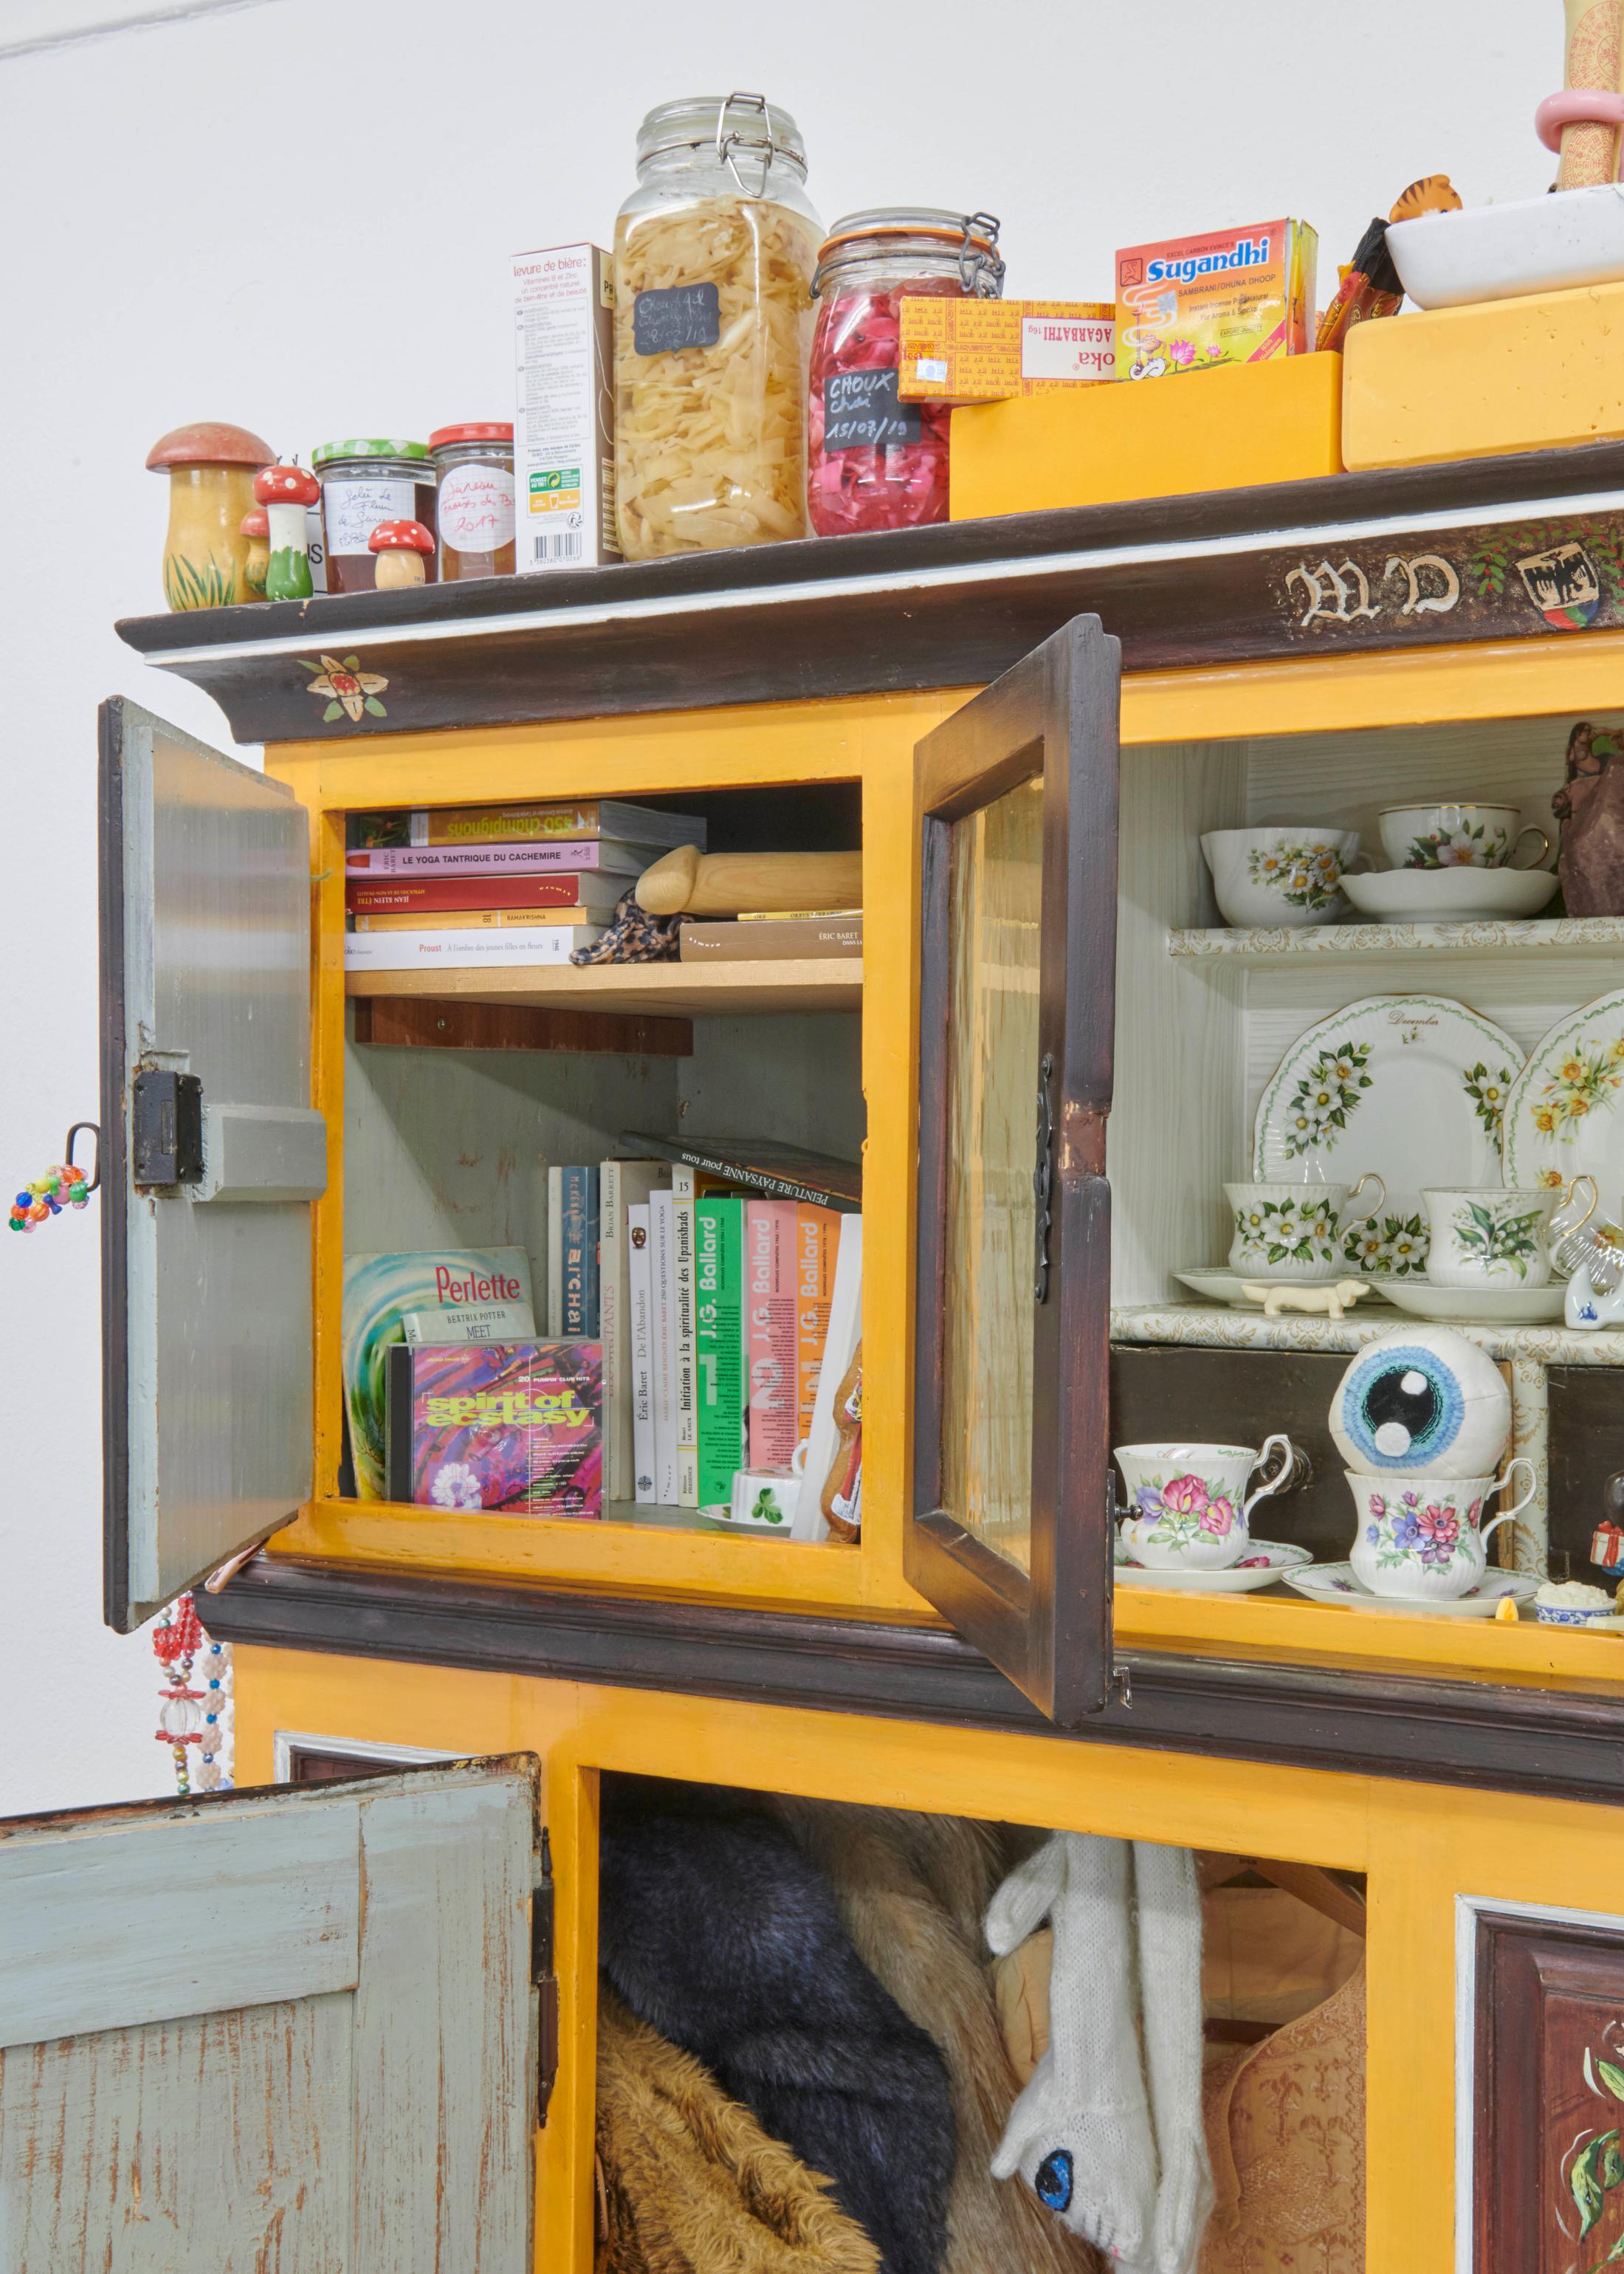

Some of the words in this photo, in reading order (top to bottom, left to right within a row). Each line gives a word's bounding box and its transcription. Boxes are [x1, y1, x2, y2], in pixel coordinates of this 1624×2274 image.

[1186, 247, 1208, 255] CARBON
[1209, 242, 1234, 252] EVINCE'S
[1147, 238, 1269, 283] Sugandhi
[514, 264, 542, 277] levure
[543, 261, 556, 272] de
[1249, 275, 1276, 284] DHOOP
[1211, 311, 1230, 319] Aroma
[1028, 326, 1042, 334] 16g
[1043, 326, 1112, 343] AGARBATHI
[1078, 351, 1115, 371] oka
[830, 372, 895, 398] CHOUX
[448, 815, 542, 839] champignons
[416, 856, 440, 864] YOGA
[443, 854, 490, 863] TANTRIQUE
[494, 853, 506, 862] DU
[509, 851, 561, 861] CACHEMIRE
[483, 914, 492, 923] 18
[819, 931, 835, 940] ÉRIC
[836, 932, 859, 940] BARET
[345, 946, 355, 955] olio
[419, 944, 442, 952] Proust
[454, 943, 475, 952] l'ombre
[475, 943, 485, 951] des
[486, 943, 503, 953] jeunes
[504, 942, 519, 951] filles
[527, 941, 543, 950] fleurs
[1388, 1010, 1438, 1026] December
[681, 1152, 700, 1165] tous
[701, 1158, 723, 1171] pour
[723, 1165, 775, 1190] PAYSANNE
[679, 1182, 689, 1192] 15
[777, 1183, 829, 1206] PEINTURE
[660, 1226, 665, 1234] LE
[678, 1211, 692, 1263] Upanishads
[699, 1217, 717, 1291] Ballard
[752, 1219, 771, 1294] Ballard
[801, 1222, 818, 1297] Ballard
[678, 1268, 689, 1282] des
[436, 1265, 520, 1303] Perlette
[447, 1313, 478, 1324] BEATRIX
[480, 1311, 506, 1321] POTTER
[636, 1289, 647, 1340] l'Abandon
[678, 1287, 692, 1339] spiritualité
[467, 1325, 491, 1339] MEET
[638, 1342, 647, 1358] De
[679, 1343, 690, 1353] la
[638, 1371, 648, 1399] Baret
[681, 1367, 691, 1411] Initiation
[427, 1390, 534, 1414] spirit
[534, 1390, 575, 1409] of
[426, 1408, 591, 1427] ecstasy
[638, 1401, 648, 1421] Éric
